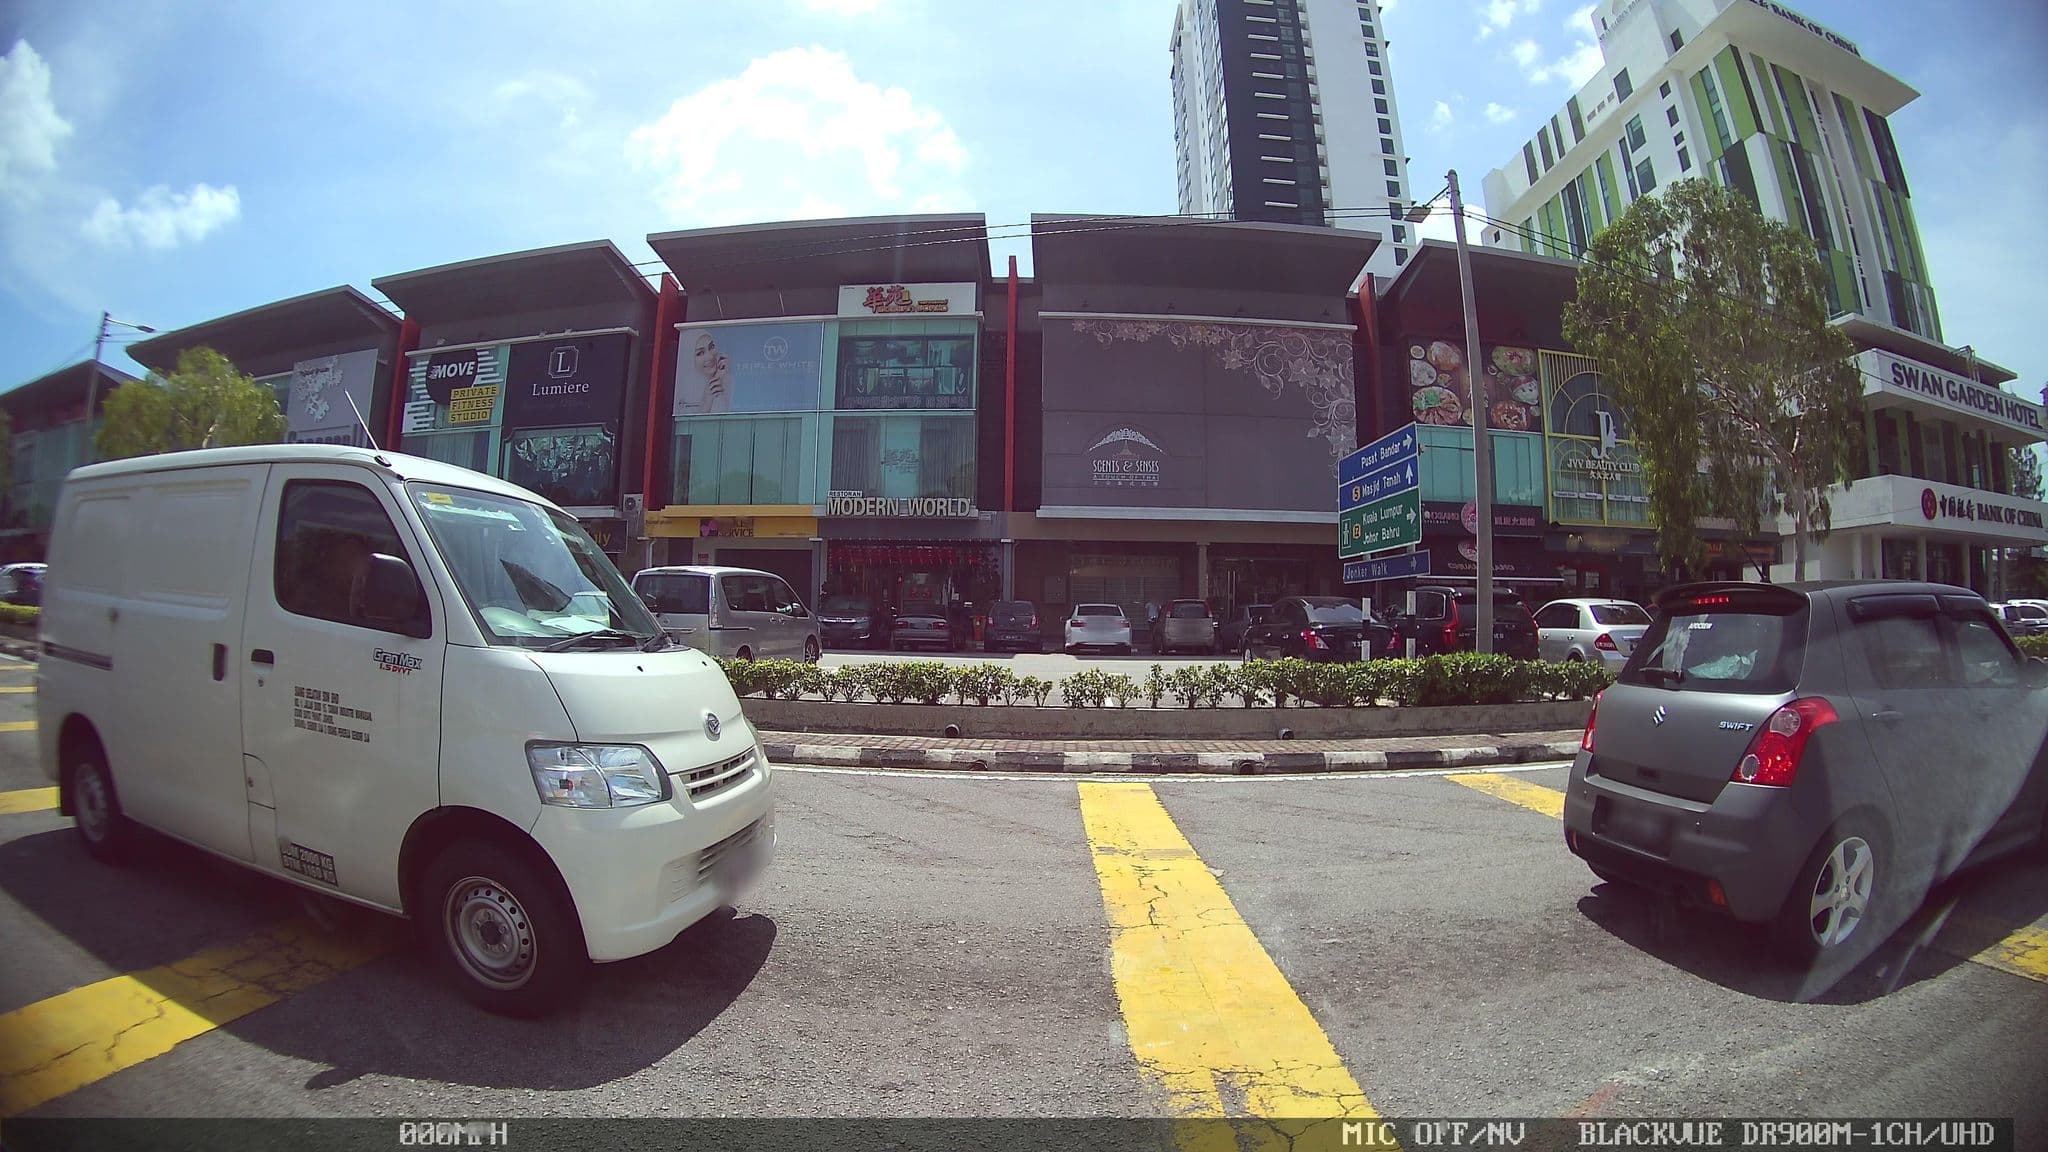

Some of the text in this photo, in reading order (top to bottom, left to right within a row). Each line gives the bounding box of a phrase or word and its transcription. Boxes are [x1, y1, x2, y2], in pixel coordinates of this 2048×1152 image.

[431, 361, 476, 379] MOVE
[556, 351, 570, 373] L
[736, 360, 817, 371] TRIPLE WHITE
[453, 386, 497, 398] PRIVATE
[532, 382, 590, 396] Lumiere
[1891, 361, 2044, 430] SWAN GARDEN HOTEL
[452, 398, 494, 410] FITNESS
[450, 410, 488, 422] STUDIO
[1361, 441, 1401, 469] Pusat Bandar
[1092, 460, 1160, 473] SCENTS & SENSES
[1585, 459, 1619, 471] BEAUTY
[1620, 462, 1640, 473] CLUB
[1362, 481, 1380, 498] Masjid
[1383, 472, 1401, 489] Tanah
[827, 497, 970, 517] MODERN WORLD
[1362, 509, 1378, 526] Kuala
[1381, 503, 1404, 520] Lumpur
[1977, 503, 2044, 528] BANK OF CHINA
[1363, 525, 1400, 545] Johor Bahru
[1346, 563, 1388, 580] Jonker Walk
[1719, 720, 1754, 731] SWIFT
